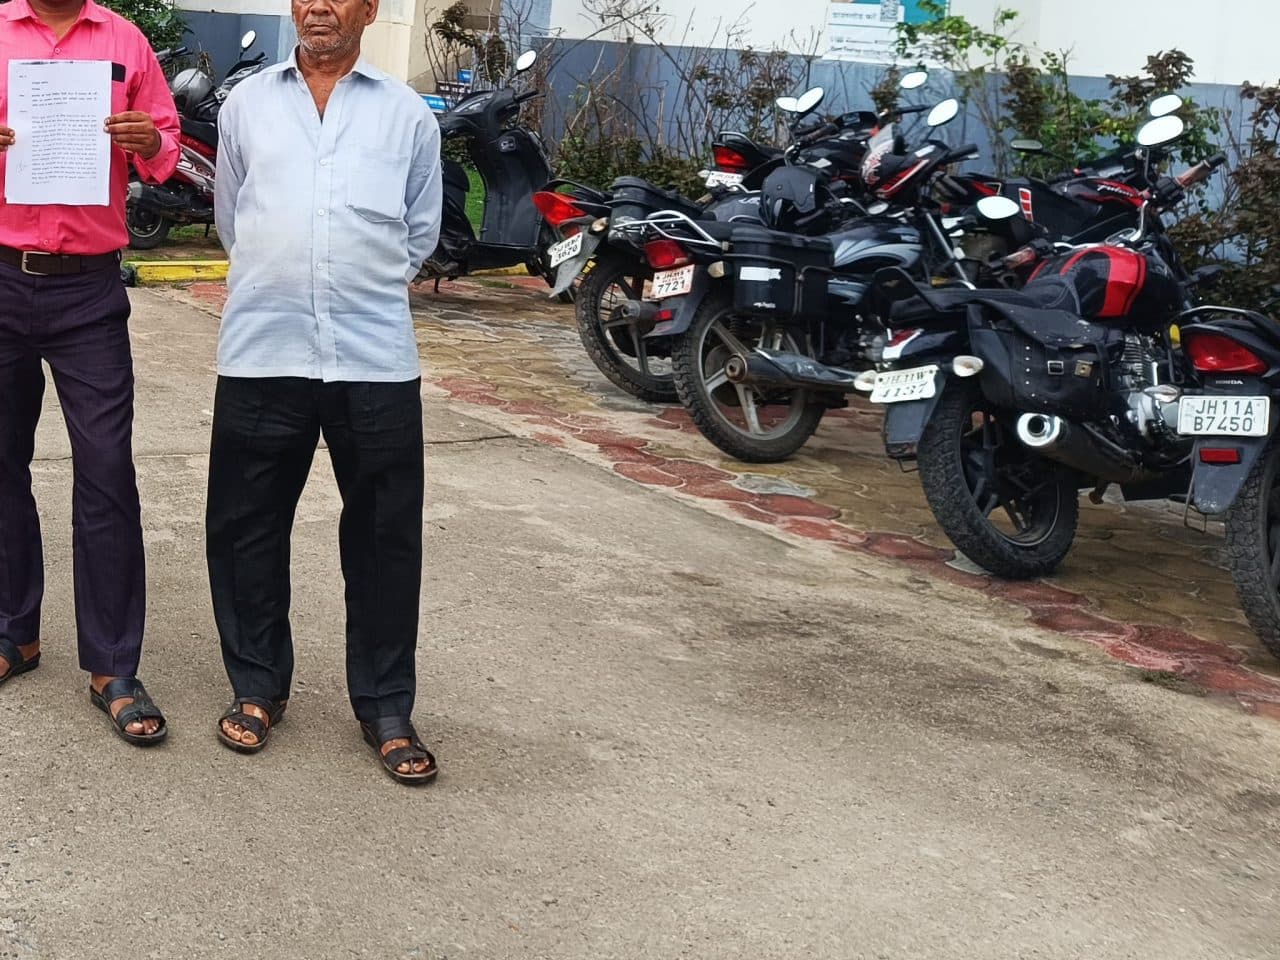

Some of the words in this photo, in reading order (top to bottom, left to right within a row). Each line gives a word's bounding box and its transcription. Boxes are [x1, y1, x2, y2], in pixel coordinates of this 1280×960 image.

[658, 280, 685, 294] 7721
[1196, 400, 1254, 416] JH11A
[1194, 416, 1254, 432] B7450
